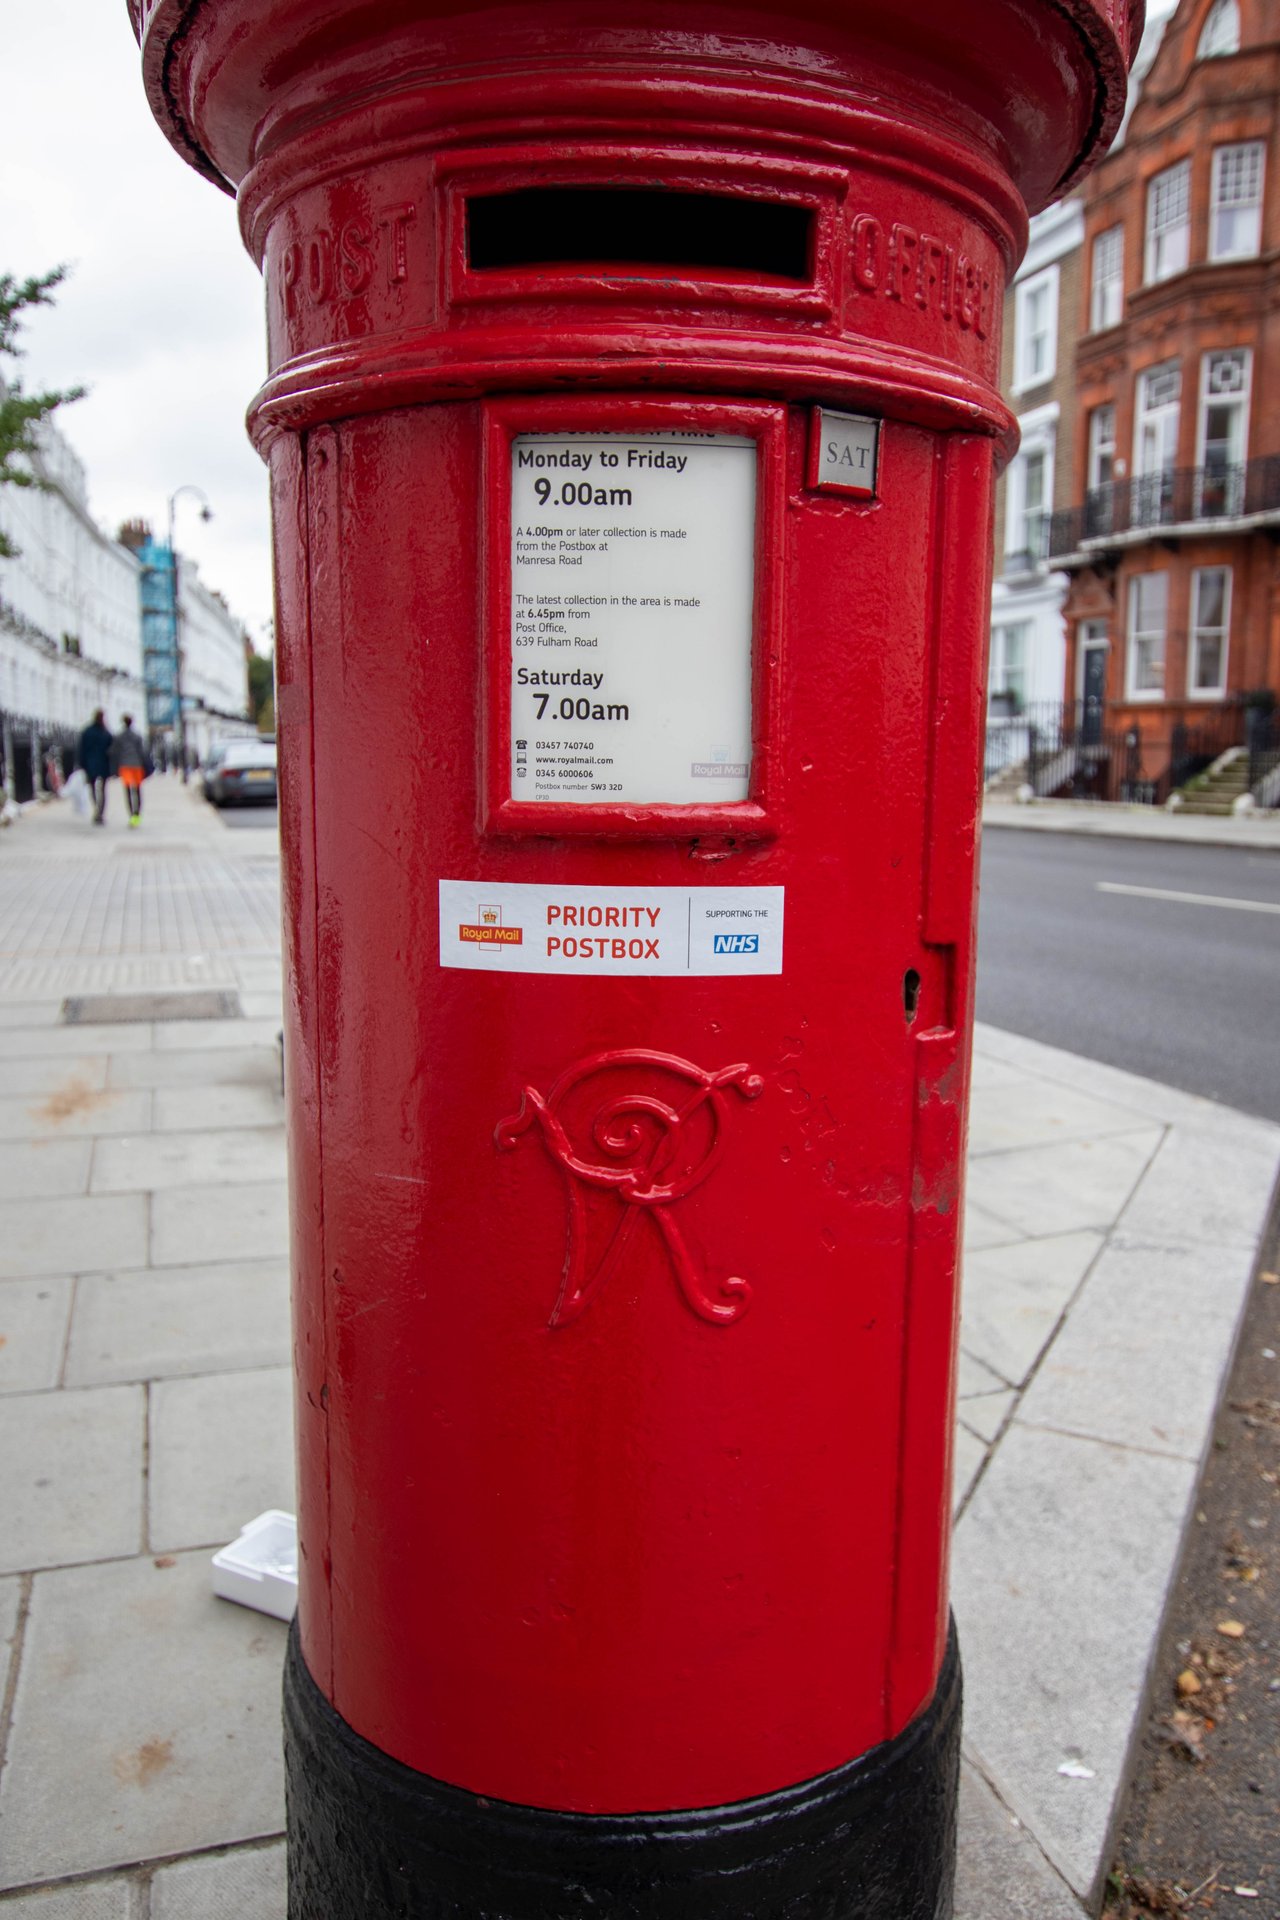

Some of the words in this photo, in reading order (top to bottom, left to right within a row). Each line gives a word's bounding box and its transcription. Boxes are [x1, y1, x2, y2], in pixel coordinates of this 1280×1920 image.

[283, 201, 416, 320] POST
[518, 449, 592, 471] Monday
[600, 451, 618, 467] to
[628, 450, 687, 472] Friday
[827, 442, 869, 467] SAT
[534, 478, 631, 505] 9.00am
[516, 526, 524, 537] A
[525, 526, 564, 539] 4.00pm
[565, 528, 577, 537] or
[578, 527, 601, 537] later
[602, 527, 647, 538] collection
[649, 527, 658, 538] is
[660, 528, 687, 539] made
[516, 540, 539, 551] from
[541, 541, 557, 551] the
[559, 540, 596, 551] Postbox
[598, 542, 609, 552] at
[516, 554, 556, 565] Manresa
[558, 554, 583, 565] Road
[515, 594, 534, 605] The
[536, 594, 562, 605] latest
[563, 594, 608, 605] collection
[610, 595, 619, 605] in
[621, 595, 638, 606] the
[639, 598, 661, 606] area
[663, 596, 672, 607] is
[674, 597, 701, 607] made
[515, 609, 525, 619] at
[527, 608, 565, 621] 6.45pm
[567, 608, 591, 619] from
[515, 622, 536, 633] Post
[538, 622, 567, 634] Office,
[515, 636, 535, 647] 639
[537, 636, 572, 647] Fulham
[574, 636, 598, 648] Road
[518, 668, 603, 689] Saturday
[533, 693, 628, 720] 7.00am
[535, 741, 561, 750] 03457
[563, 741, 594, 751] 740740
[535, 755, 614, 766] www.royalmail.com
[535, 769, 556, 778] 0345
[558, 769, 594, 778] 6000606
[695, 764, 722, 777] Royal
[724, 764, 746, 775] Mail
[535, 782, 561, 790] Postbox
[562, 783, 588, 791] number
[590, 783, 607, 791] SW3
[546, 905, 661, 928] PRIORITY
[705, 909, 753, 918] SUPPORTING
[753, 909, 769, 918] THE
[462, 927, 493, 941] Royal
[495, 929, 520, 942] Mail
[546, 936, 660, 960] POSTBOX
[716, 935, 757, 953] NHS
